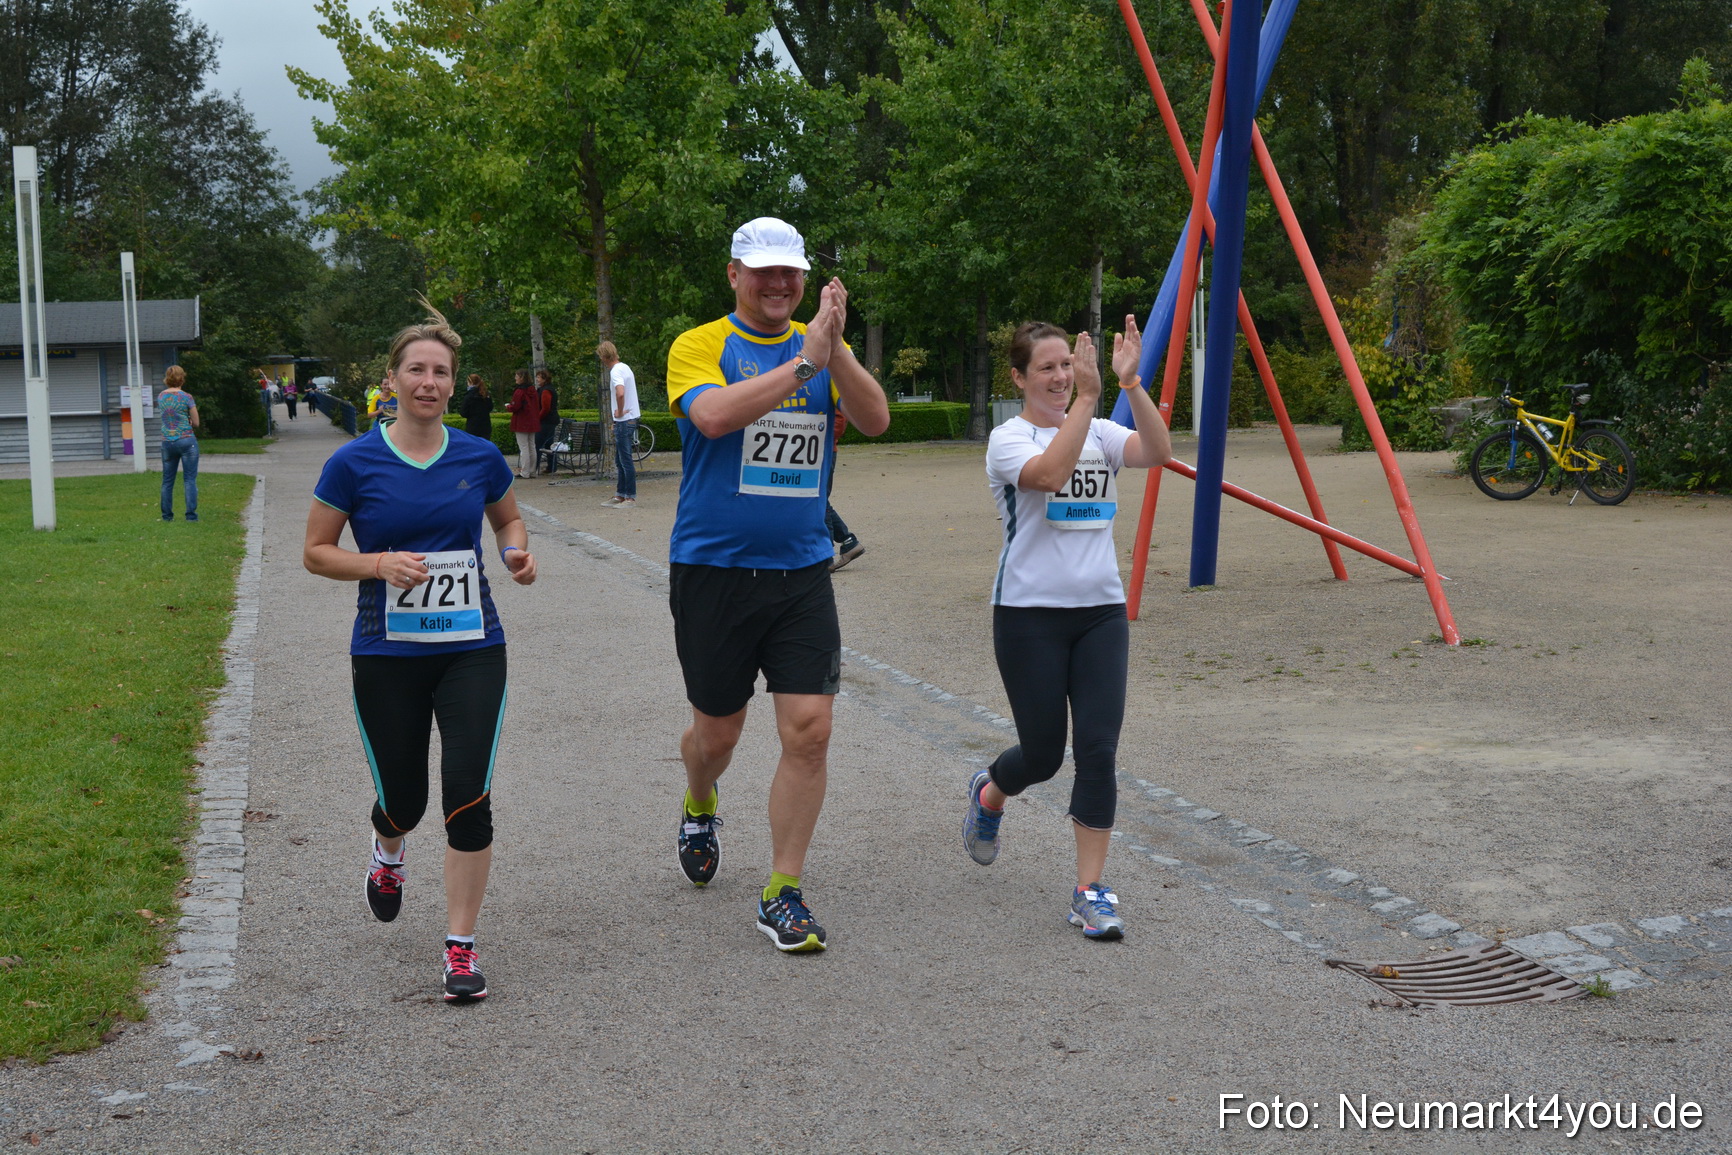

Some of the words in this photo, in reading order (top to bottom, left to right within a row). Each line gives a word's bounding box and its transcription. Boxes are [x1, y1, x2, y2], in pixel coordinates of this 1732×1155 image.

[778, 421, 816, 431] Neumarkt
[752, 431, 819, 465] 2720
[770, 471, 801, 485] David
[1065, 506, 1101, 518] Annette
[420, 616, 452, 632] Katja
